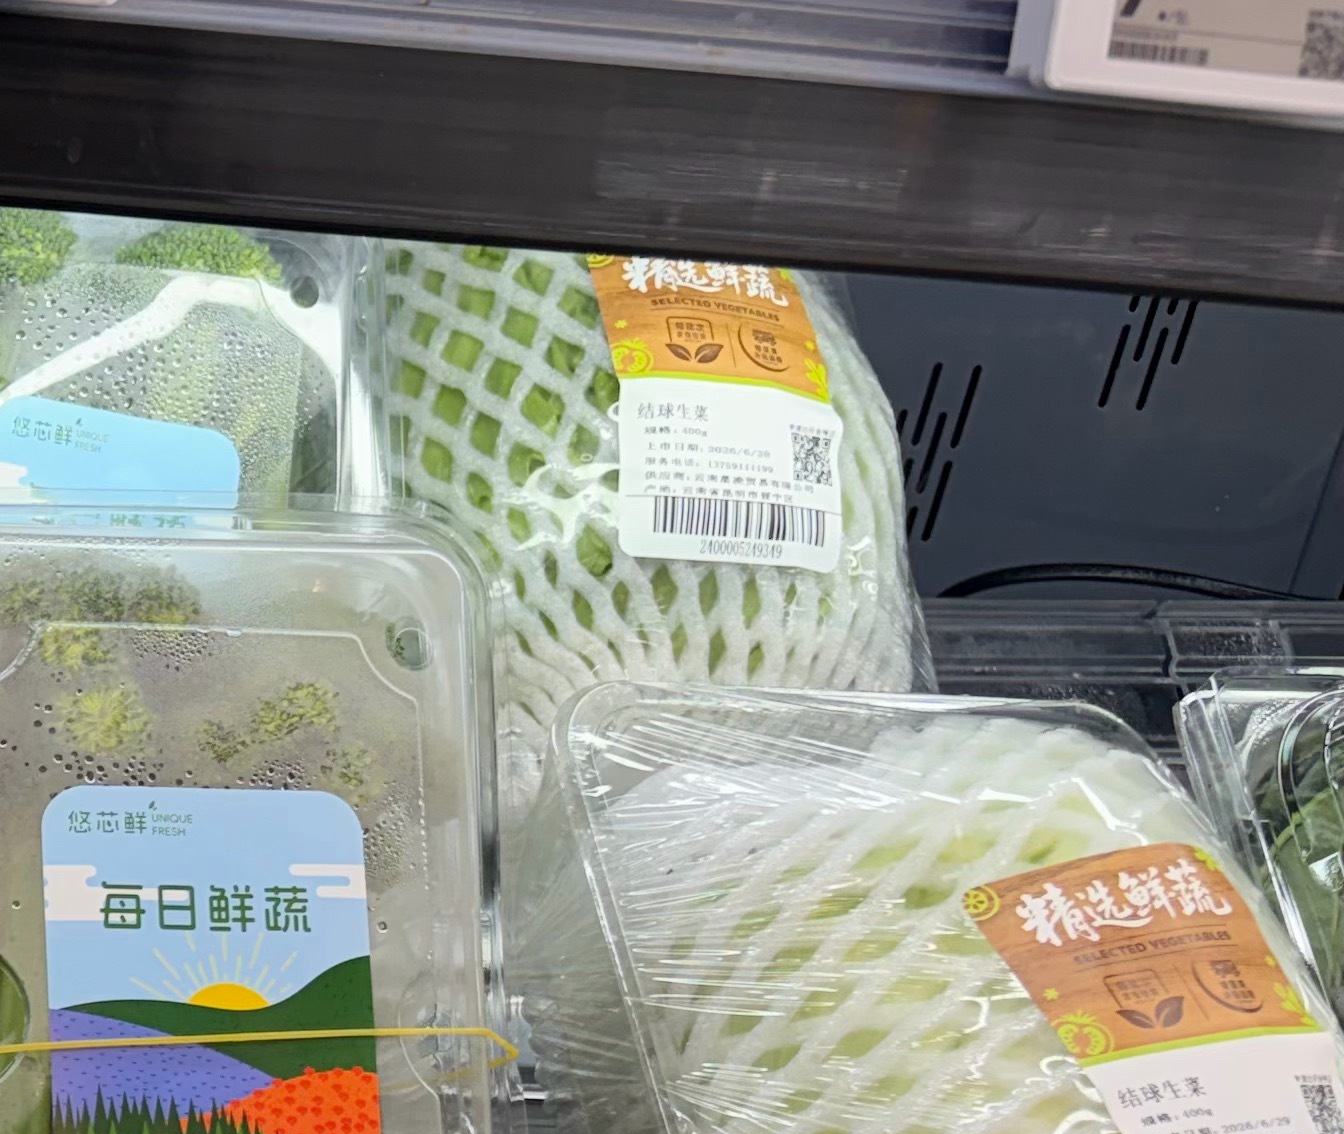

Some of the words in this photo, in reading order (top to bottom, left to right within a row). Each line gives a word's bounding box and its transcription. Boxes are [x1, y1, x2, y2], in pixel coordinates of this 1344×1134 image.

[651, 297, 711, 308] SELECTED
[714, 301, 780, 322] VEGETABLES
[638, 402, 709, 422] 结球生菜
[11, 415, 73, 447] 悠芯鲜
[68, 809, 147, 835] 悠芯鲜
[151, 812, 193, 825] UNIQUE
[151, 826, 186, 837] FRESH
[99, 881, 312, 933] 每日鲜蔬
[1016, 858, 1232, 947] 精选鲜蔬
[1073, 940, 1146, 964] SELECTED
[1149, 931, 1232, 951] VEGETABLES
[1117, 1076, 1207, 1109] 结球生菜
